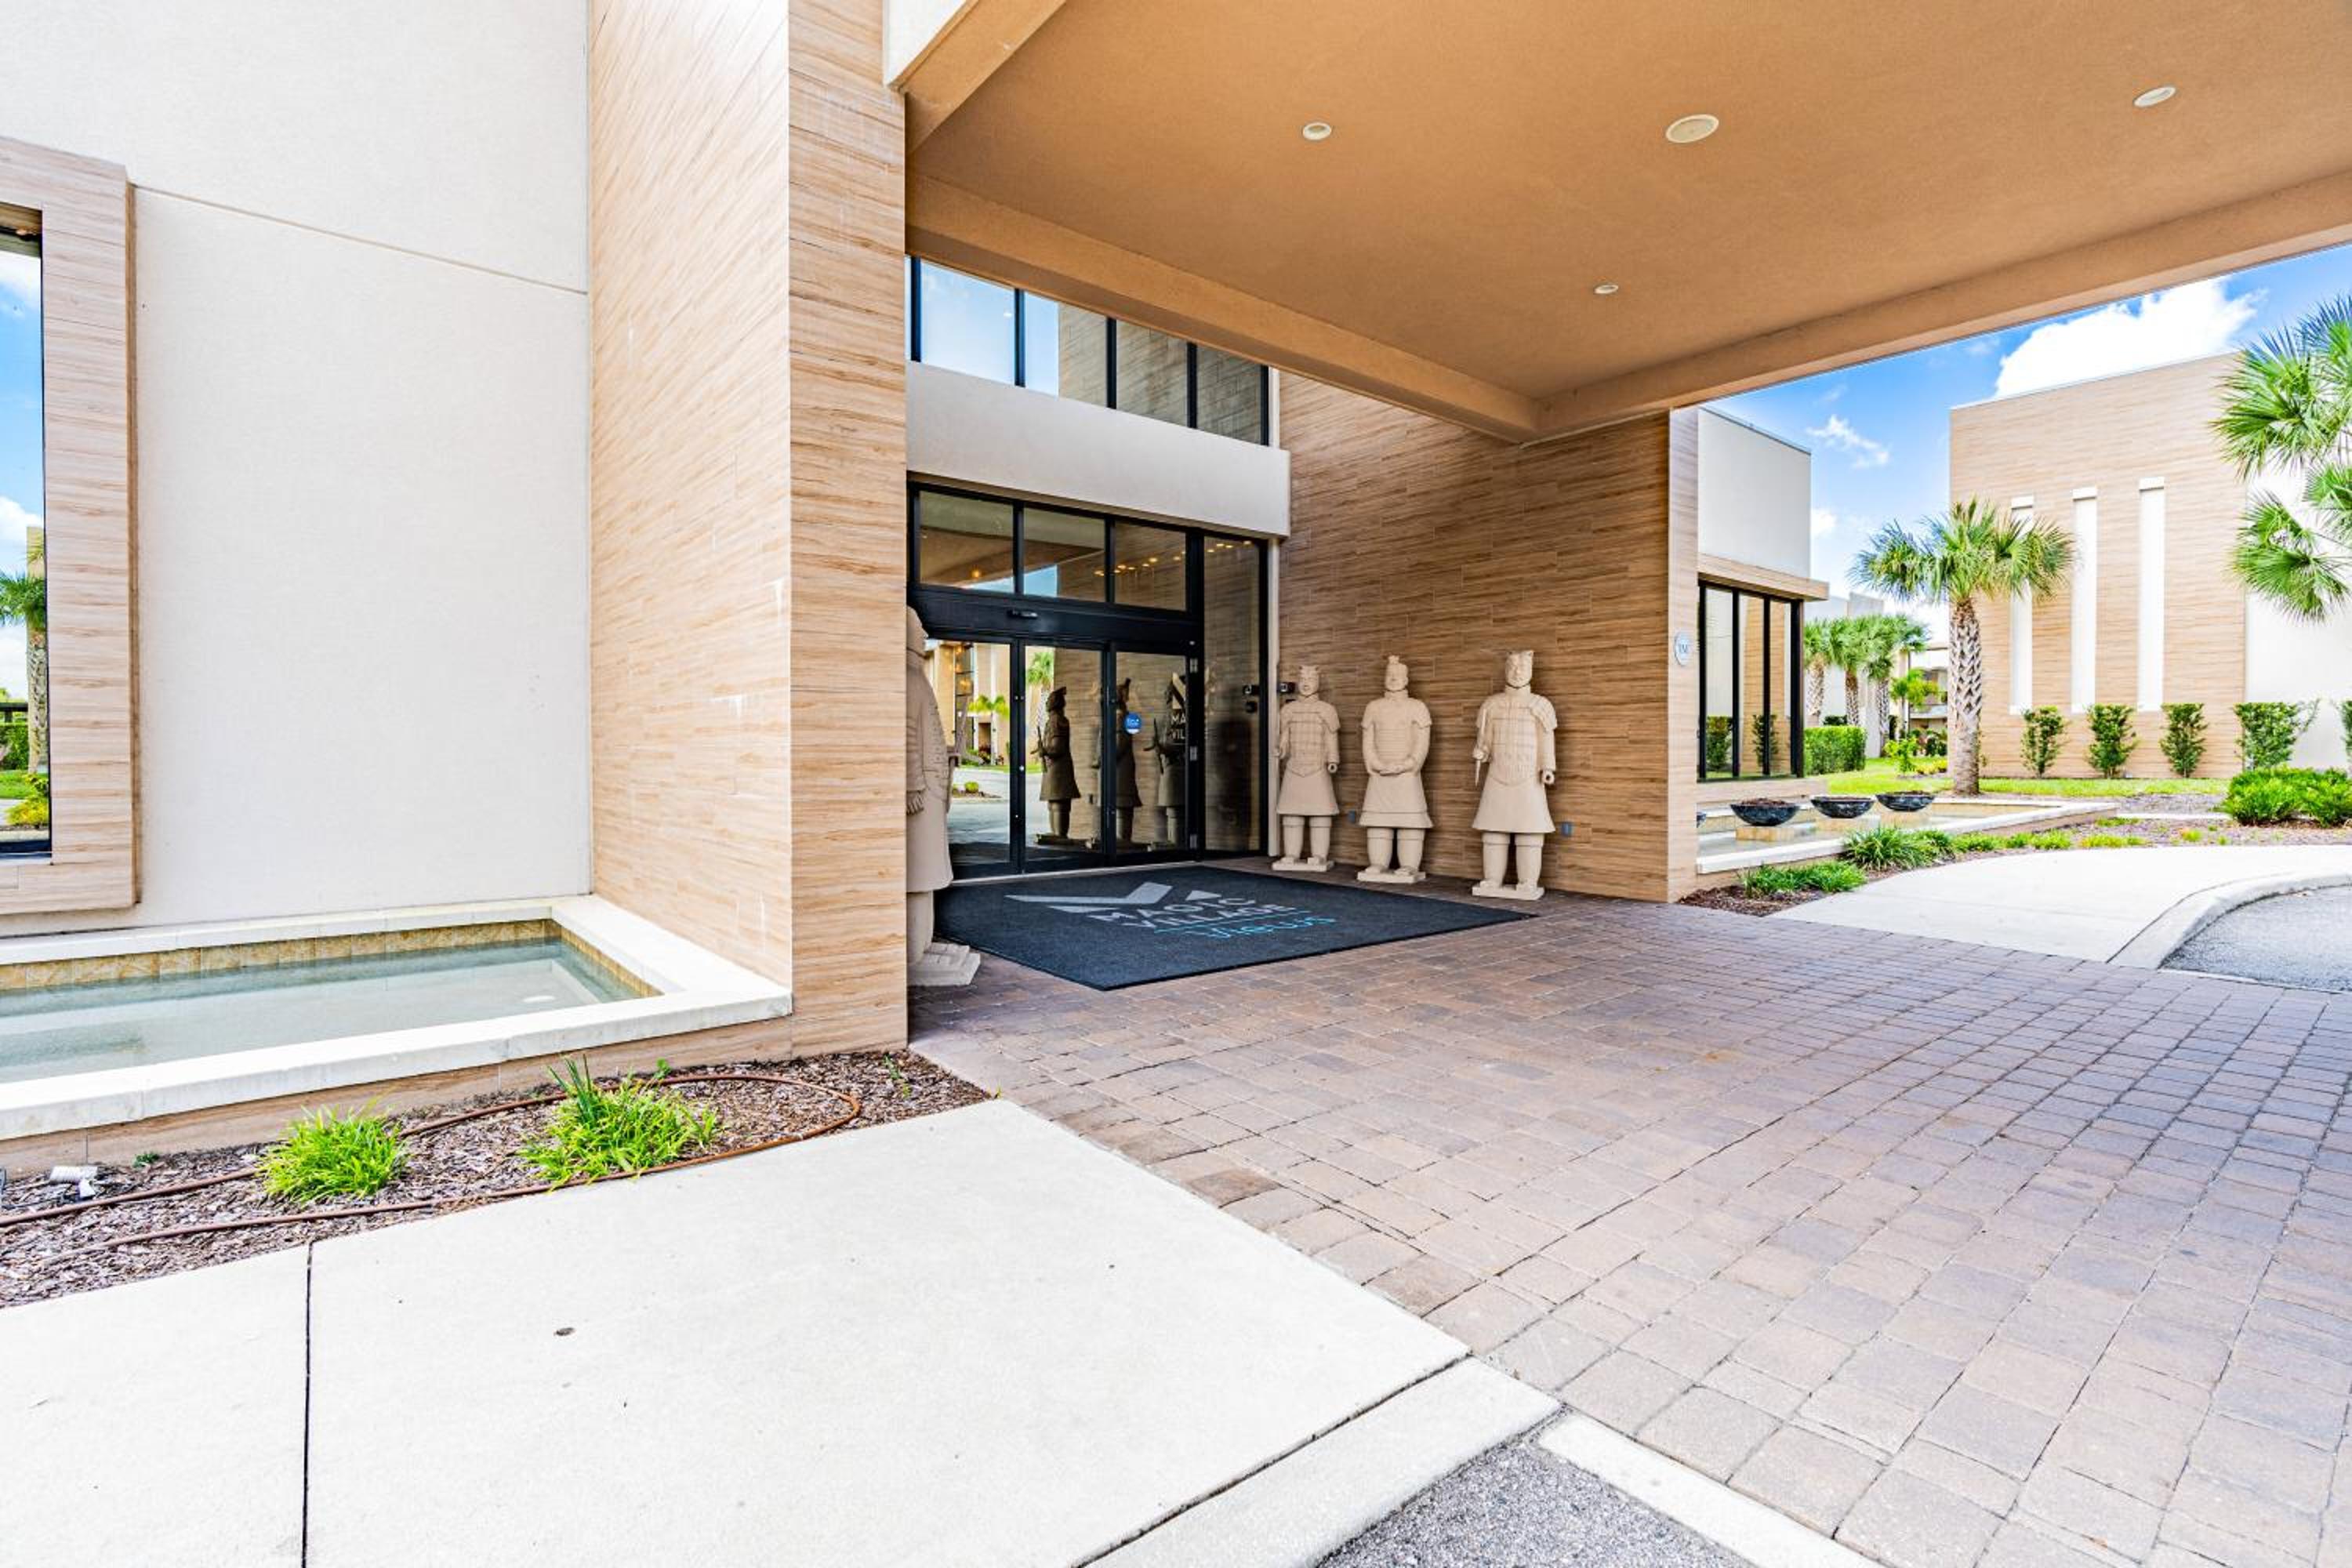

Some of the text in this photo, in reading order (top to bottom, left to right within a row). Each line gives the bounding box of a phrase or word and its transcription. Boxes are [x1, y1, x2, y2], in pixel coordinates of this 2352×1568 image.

[1171, 713, 1186, 724] MA
[1168, 729, 1186, 739] VIL
[1086, 898, 1256, 921] MAGIC
[1121, 904, 1296, 928] VILLAGE
